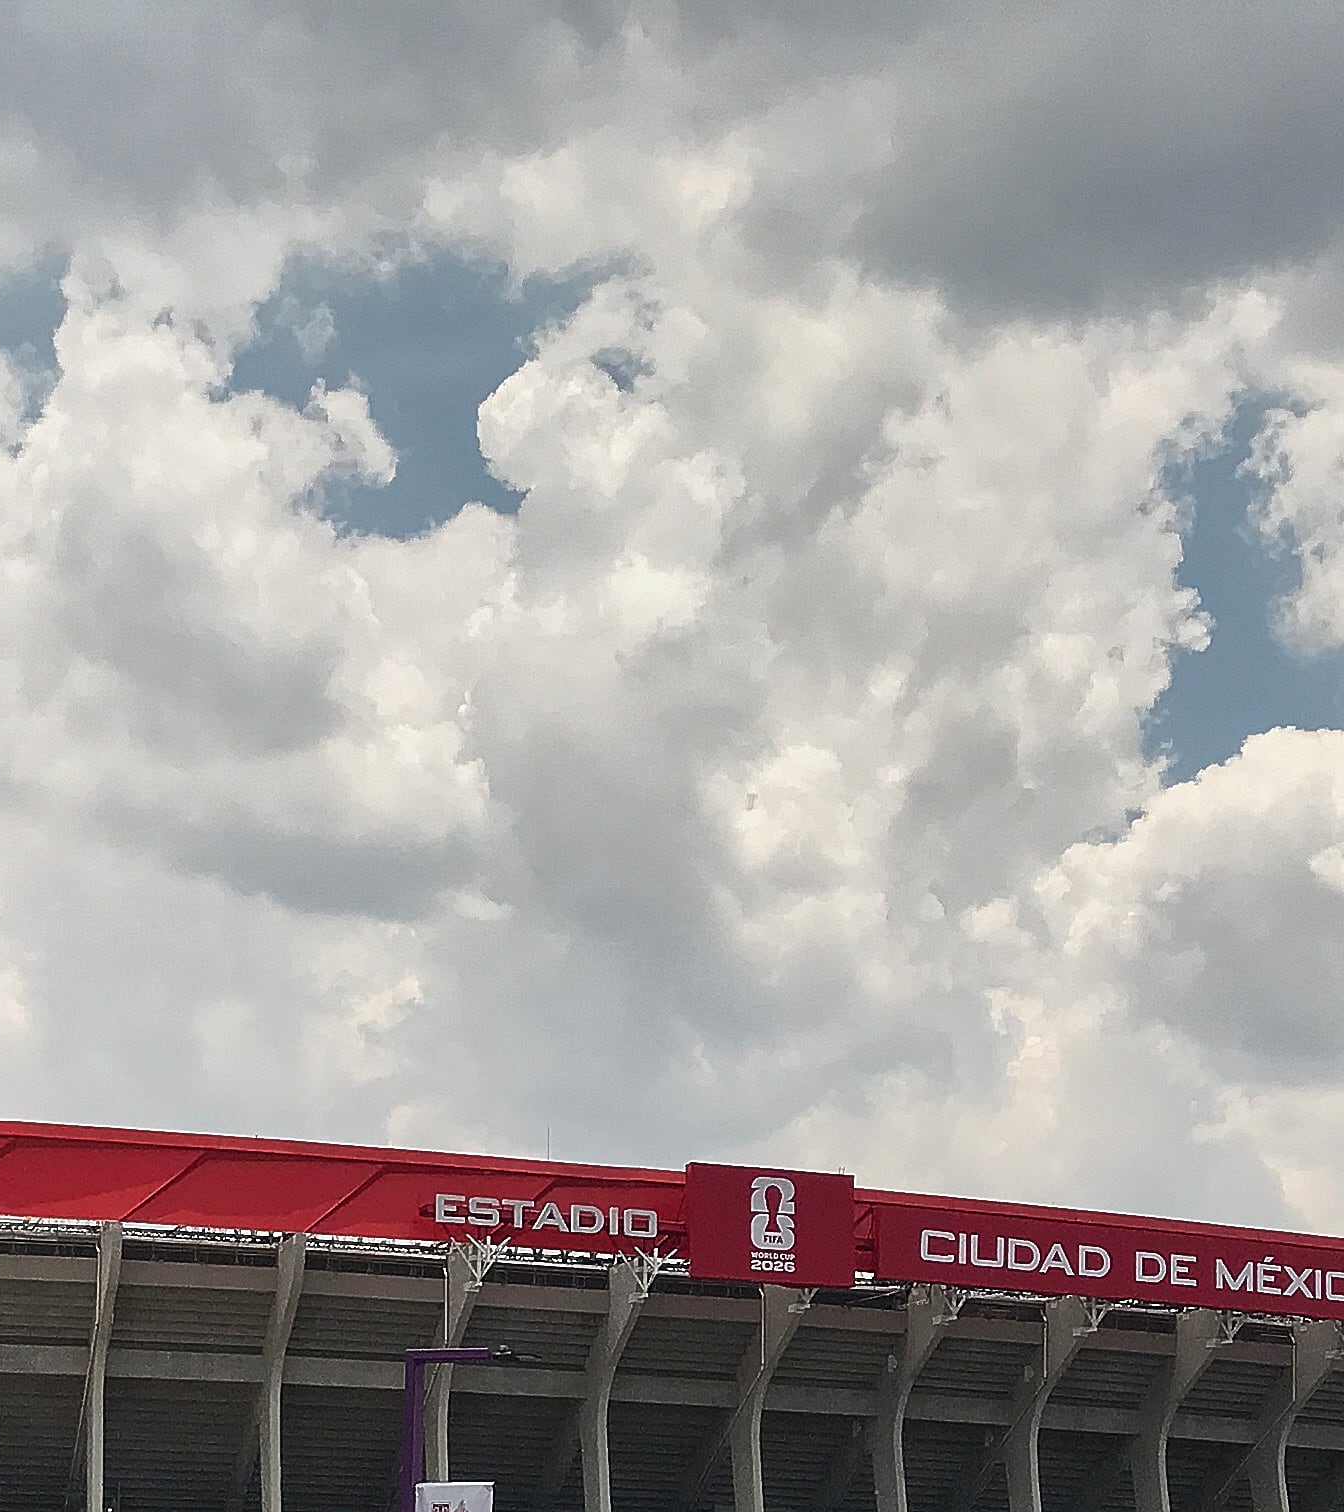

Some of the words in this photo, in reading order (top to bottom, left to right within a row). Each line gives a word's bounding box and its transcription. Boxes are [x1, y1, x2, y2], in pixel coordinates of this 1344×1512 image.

[434, 1192, 658, 1239] ESTADIO
[763, 1234, 784, 1245] FIFA
[750, 1251, 779, 1260] WORLD
[779, 1253, 796, 1261] CUP
[919, 1229, 1112, 1279] CIUDAD
[1134, 1250, 1198, 1288] DE
[750, 1259, 796, 1273] 2026
